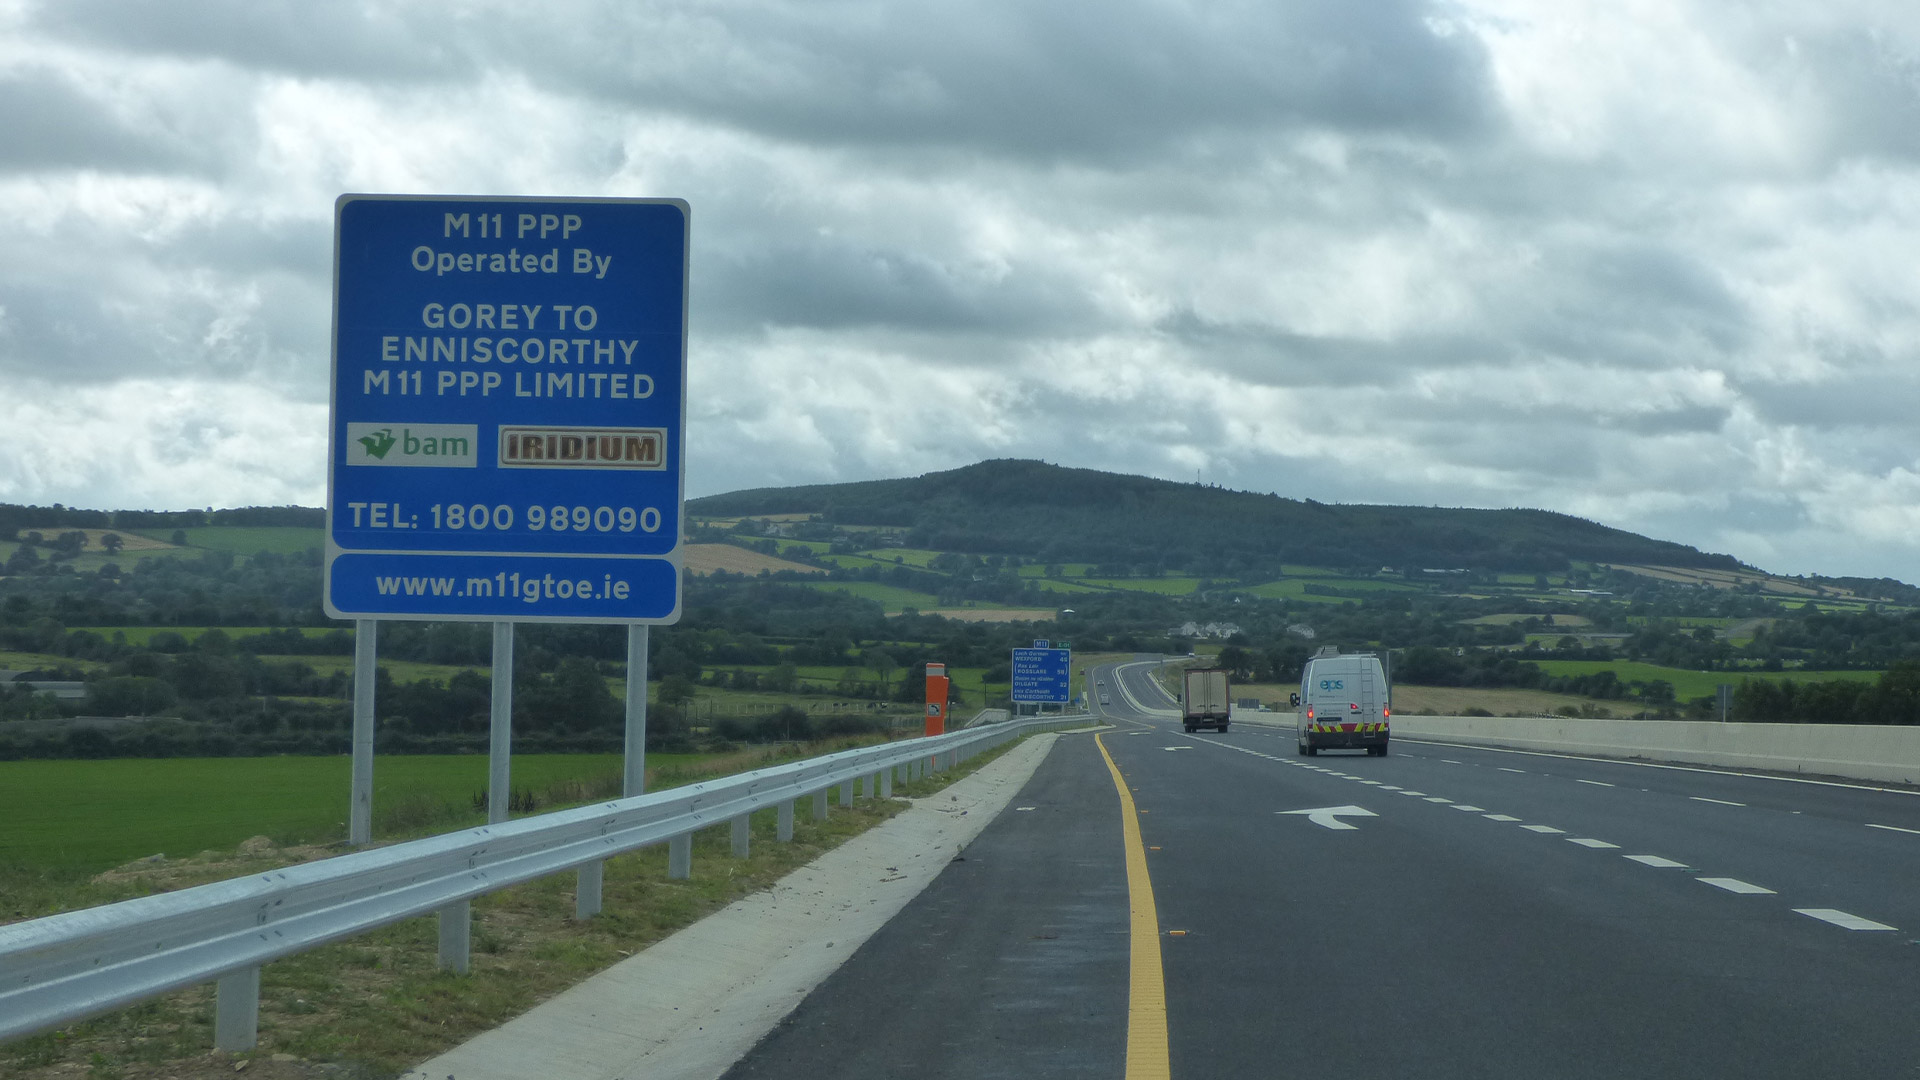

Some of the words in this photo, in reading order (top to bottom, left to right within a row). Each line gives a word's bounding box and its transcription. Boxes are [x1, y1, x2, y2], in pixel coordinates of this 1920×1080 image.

[445, 212, 501, 239] M11
[518, 213, 582, 240] PPP
[411, 245, 559, 277] Operated
[573, 248, 612, 279] By
[422, 302, 542, 330] GOREY
[553, 305, 598, 331] TO
[382, 336, 639, 365] ENNISCORTHY
[363, 369, 422, 396] M11
[437, 370, 502, 397] PPP
[515, 371, 655, 399] LIMITED
[403, 429, 468, 456] bam
[507, 434, 656, 462] IRIDIUM
[347, 502, 418, 529] TEL:
[430, 503, 514, 531] 1800
[527, 505, 662, 533] 989090
[376, 571, 630, 603] www.m11gtoe.ie
[1320, 680, 1343, 692] eps
